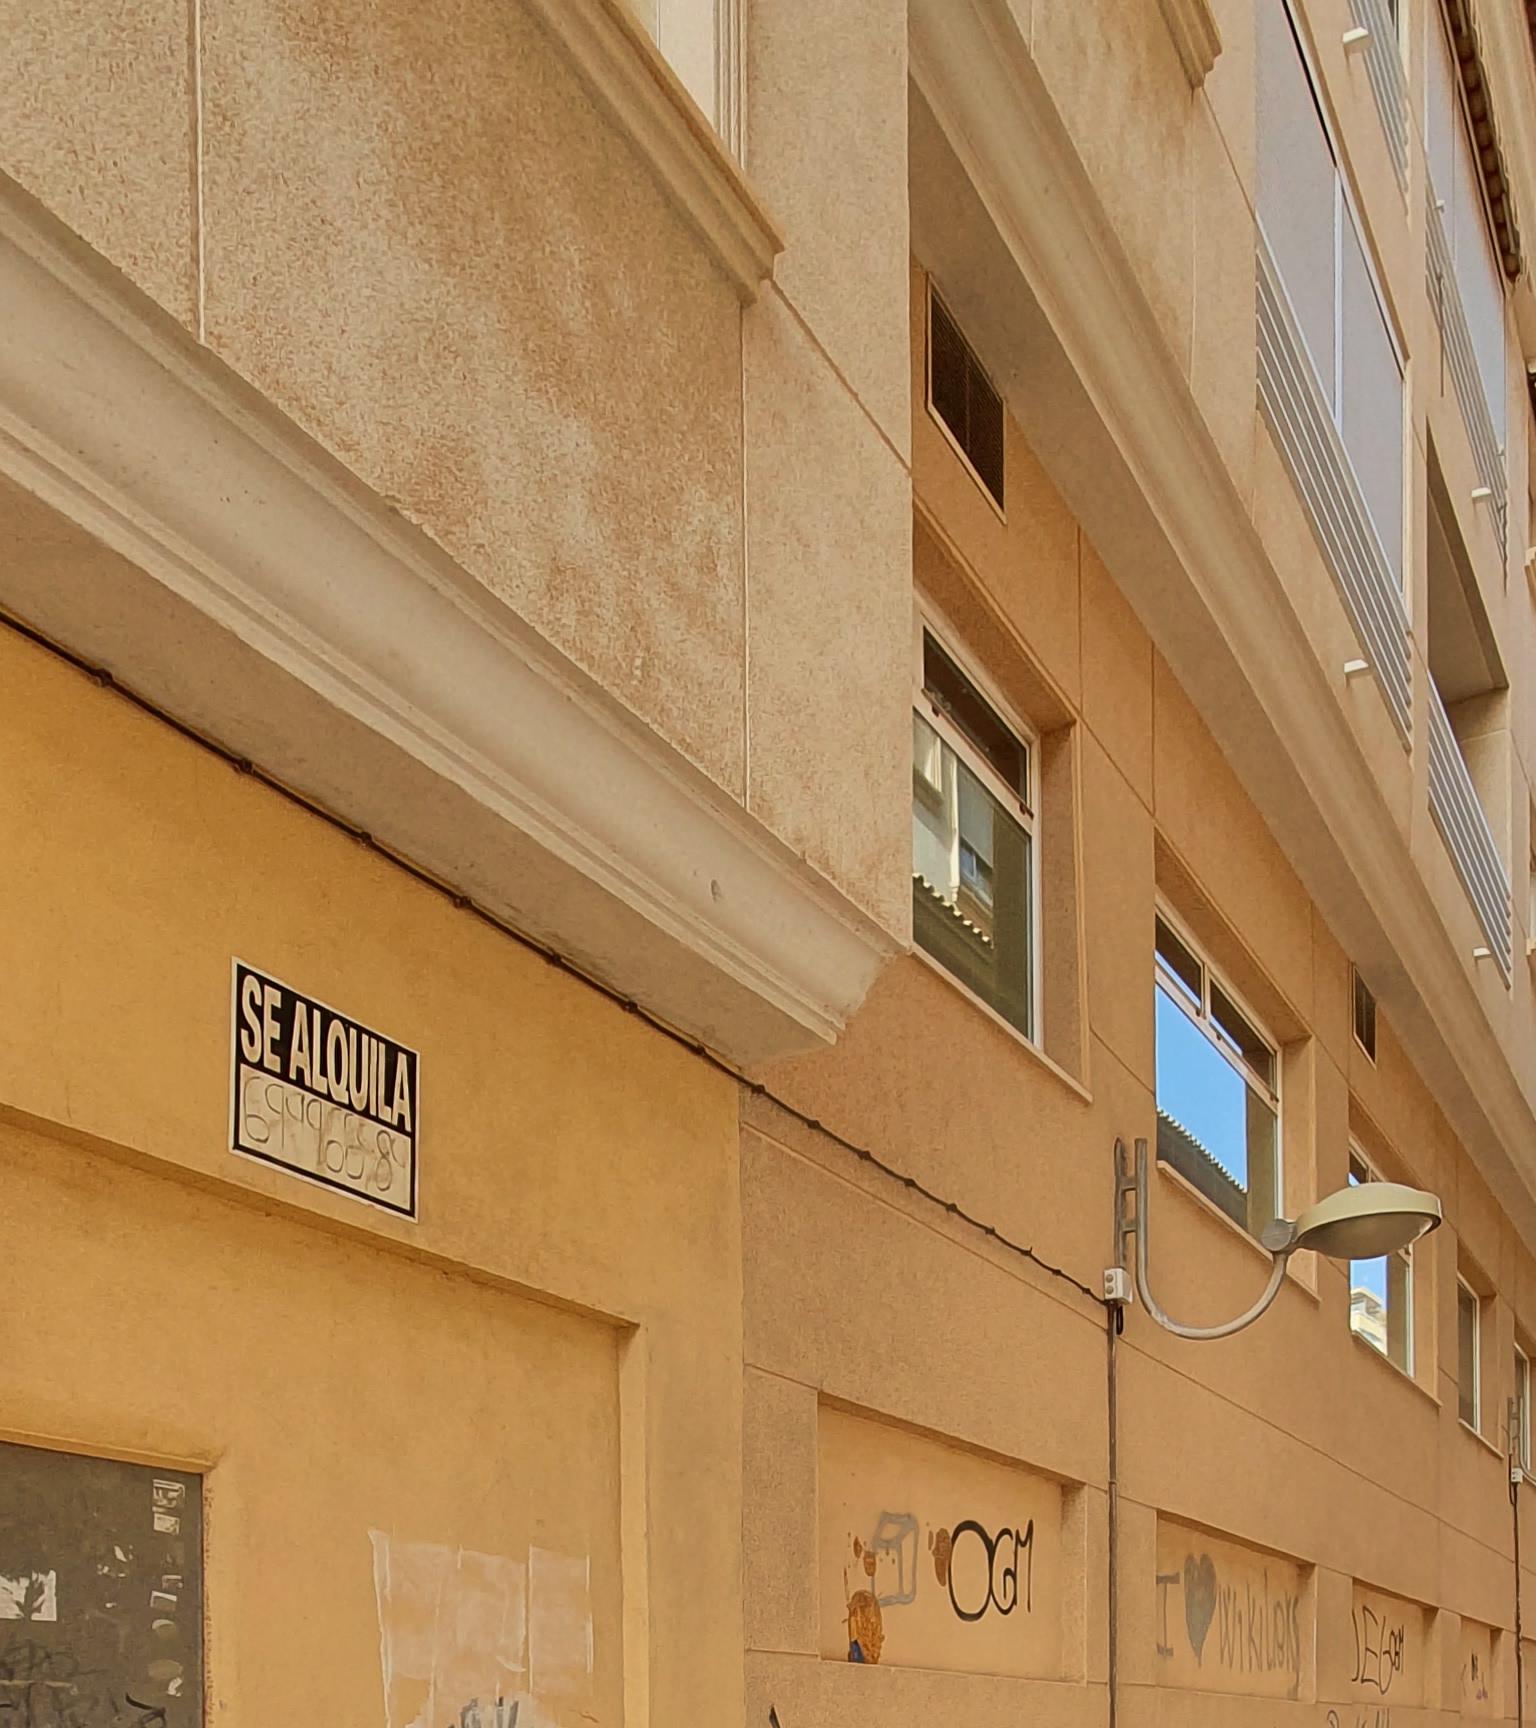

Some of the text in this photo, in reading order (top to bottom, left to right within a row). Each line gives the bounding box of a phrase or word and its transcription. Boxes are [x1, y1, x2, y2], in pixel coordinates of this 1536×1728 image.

[240, 974, 412, 1132] SE ALQUILA
[949, 1519, 1034, 1622] OGM
